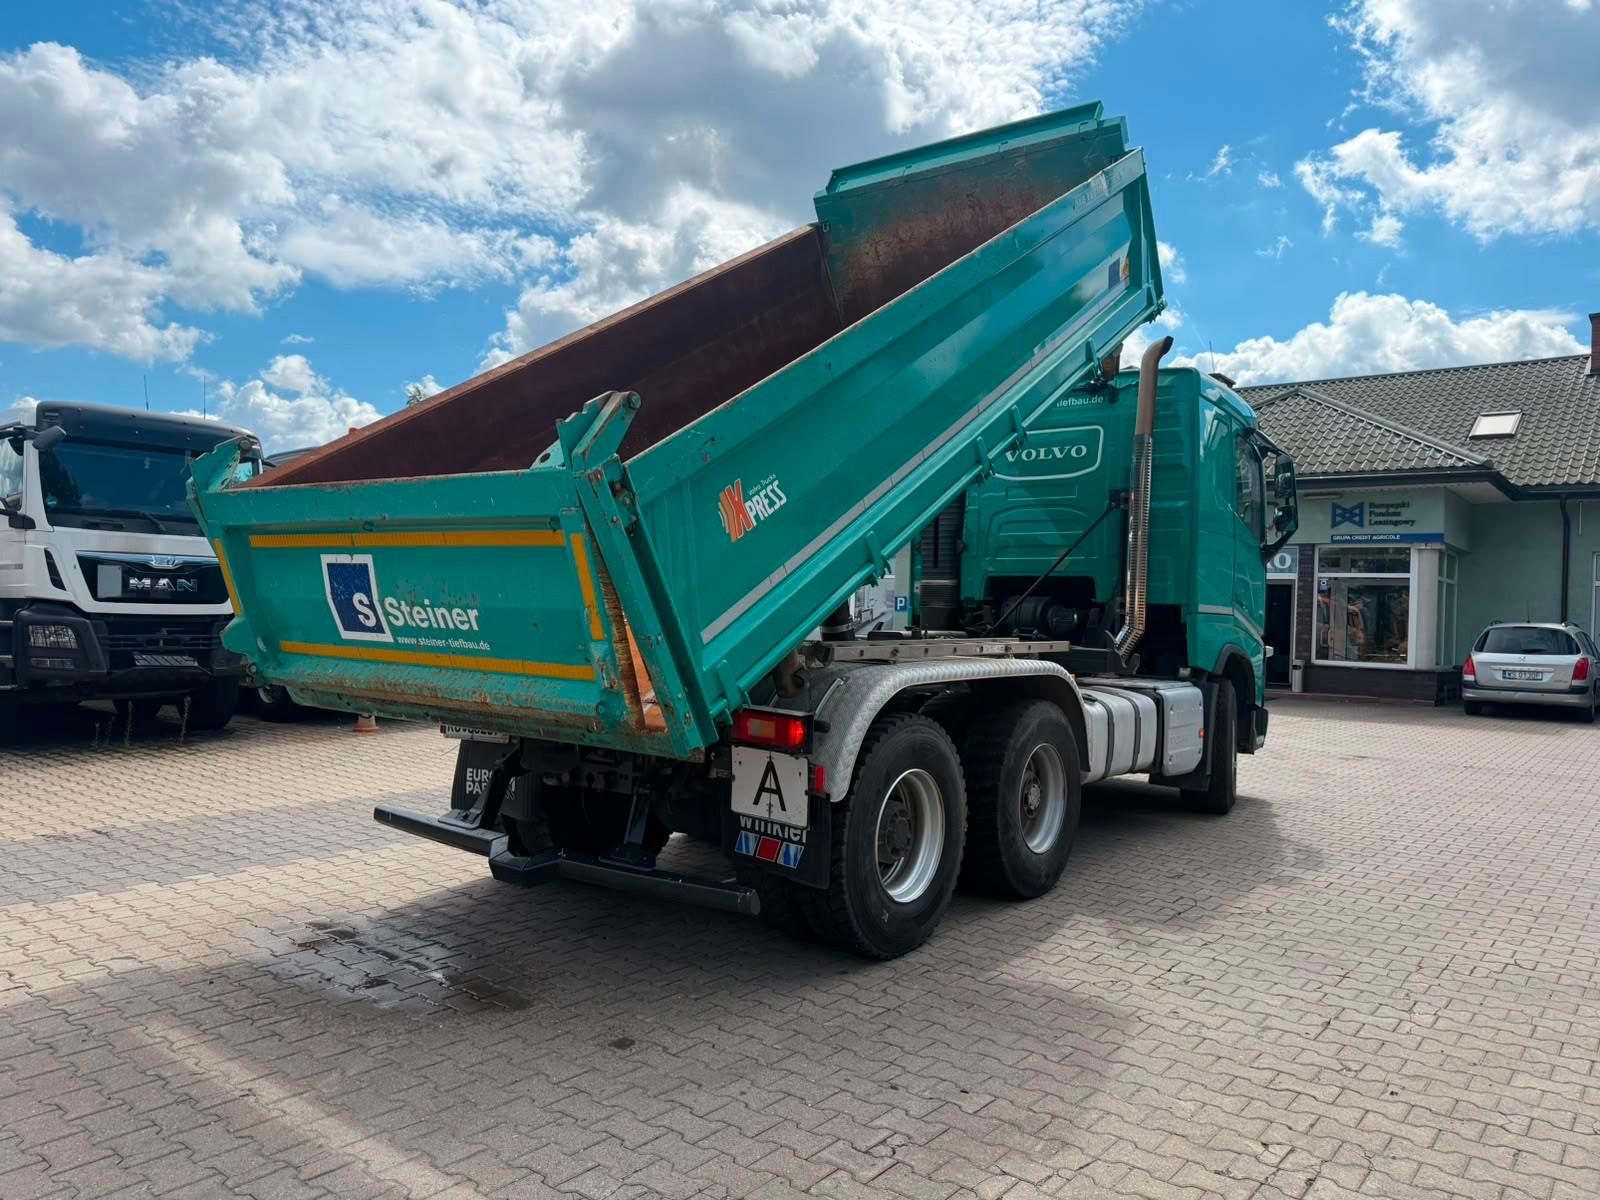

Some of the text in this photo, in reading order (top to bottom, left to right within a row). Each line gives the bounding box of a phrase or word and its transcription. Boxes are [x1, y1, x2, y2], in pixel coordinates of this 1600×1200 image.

[1004, 444, 1088, 463] VOLVO
[128, 577, 198, 592] MAN
[352, 592, 480, 632] S Steiner
[897, 597, 905, 610] P
[397, 636, 491, 651] www.steiner-tiefbau.de
[752, 760, 787, 812] A
